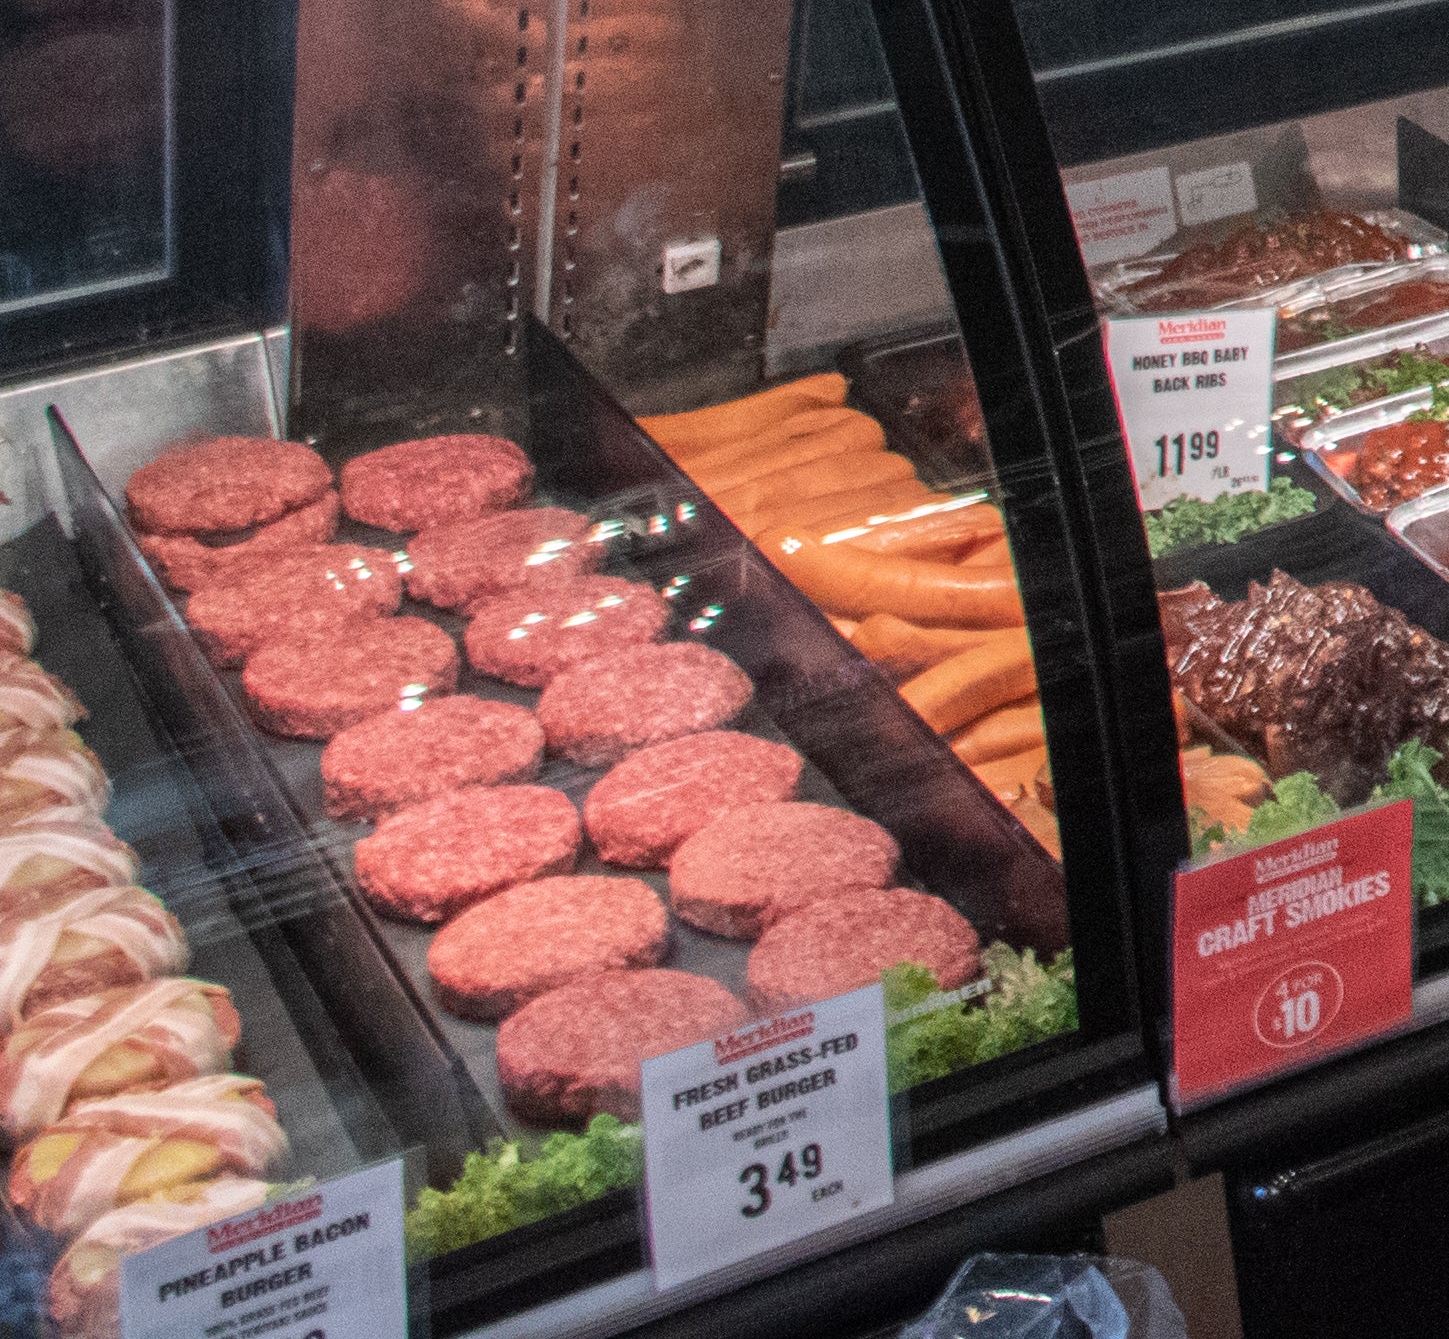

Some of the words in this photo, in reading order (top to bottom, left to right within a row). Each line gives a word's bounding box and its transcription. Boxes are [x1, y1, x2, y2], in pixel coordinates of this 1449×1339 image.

[1157, 317, 1229, 337] Meridian
[1132, 350, 1179, 372] HONEY
[1182, 348, 1211, 369] BBQ
[1213, 345, 1251, 367] BABY
[1152, 373, 1190, 395] BACK
[1191, 370, 1228, 391] RIBS
[1196, 908, 1279, 959] CRAFT
[1284, 870, 1392, 929] SMOKIES
[672, 1072, 740, 1111] FRESH
[745, 1032, 859, 1085] GRASS-FED
[699, 1099, 751, 1132] BEEF
[756, 1068, 837, 1111] BURGER
[158, 1241, 287, 1304] PINEAPPLE
[293, 1211, 372, 1254] BACON
[220, 1261, 314, 1309] BURGER
